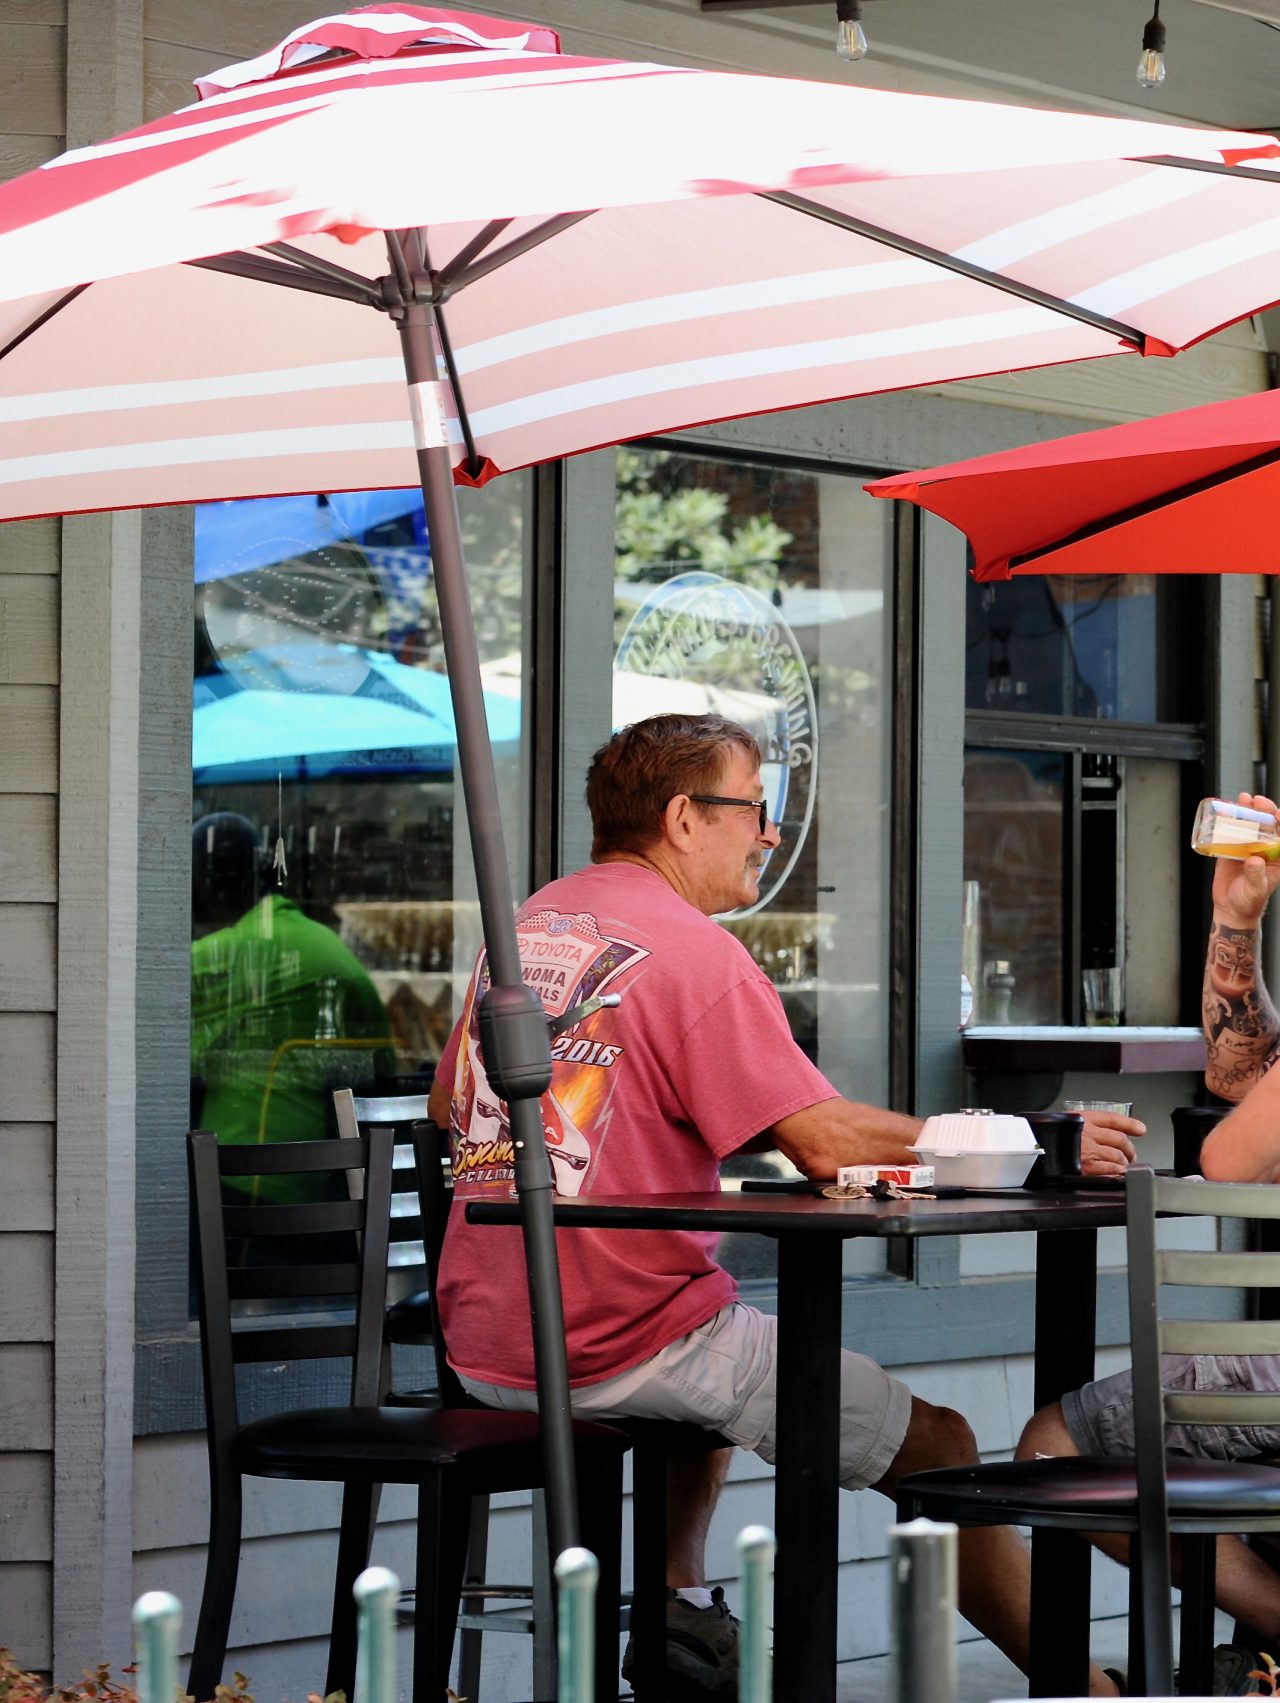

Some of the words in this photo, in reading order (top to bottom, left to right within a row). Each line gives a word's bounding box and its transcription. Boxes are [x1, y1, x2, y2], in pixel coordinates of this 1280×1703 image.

[530, 942, 583, 962] TOYOTA
[522, 967, 567, 987] NOMA
[551, 1036, 624, 1067] 2016
